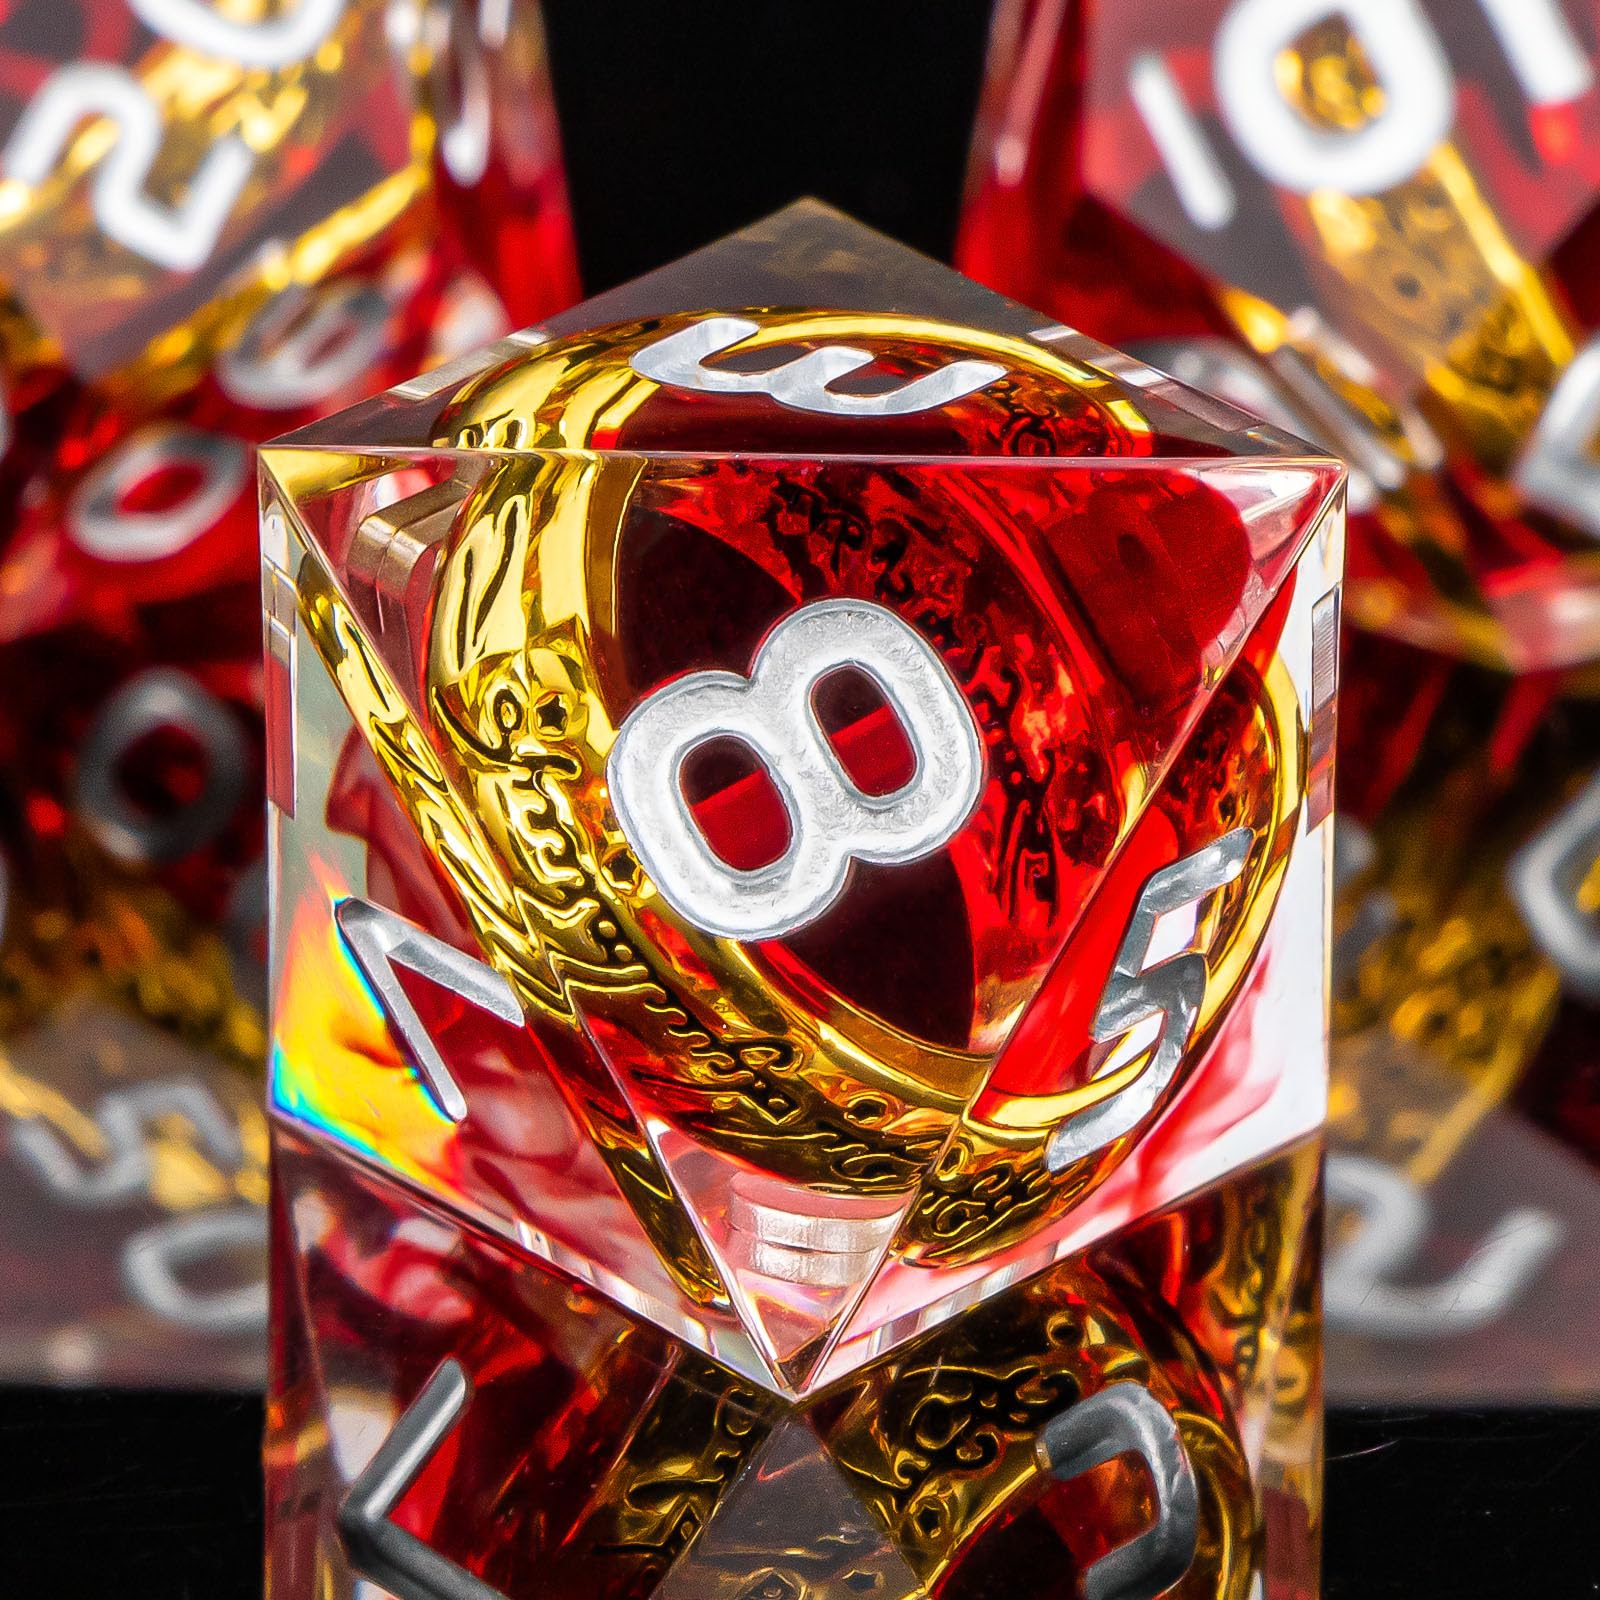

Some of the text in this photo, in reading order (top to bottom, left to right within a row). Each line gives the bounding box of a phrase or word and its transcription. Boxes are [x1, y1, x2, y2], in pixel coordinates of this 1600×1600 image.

[628, 316, 1009, 417] 3
[605, 597, 985, 942] 8
[334, 895, 527, 1124] 7
[1045, 826, 1257, 1177] 5
